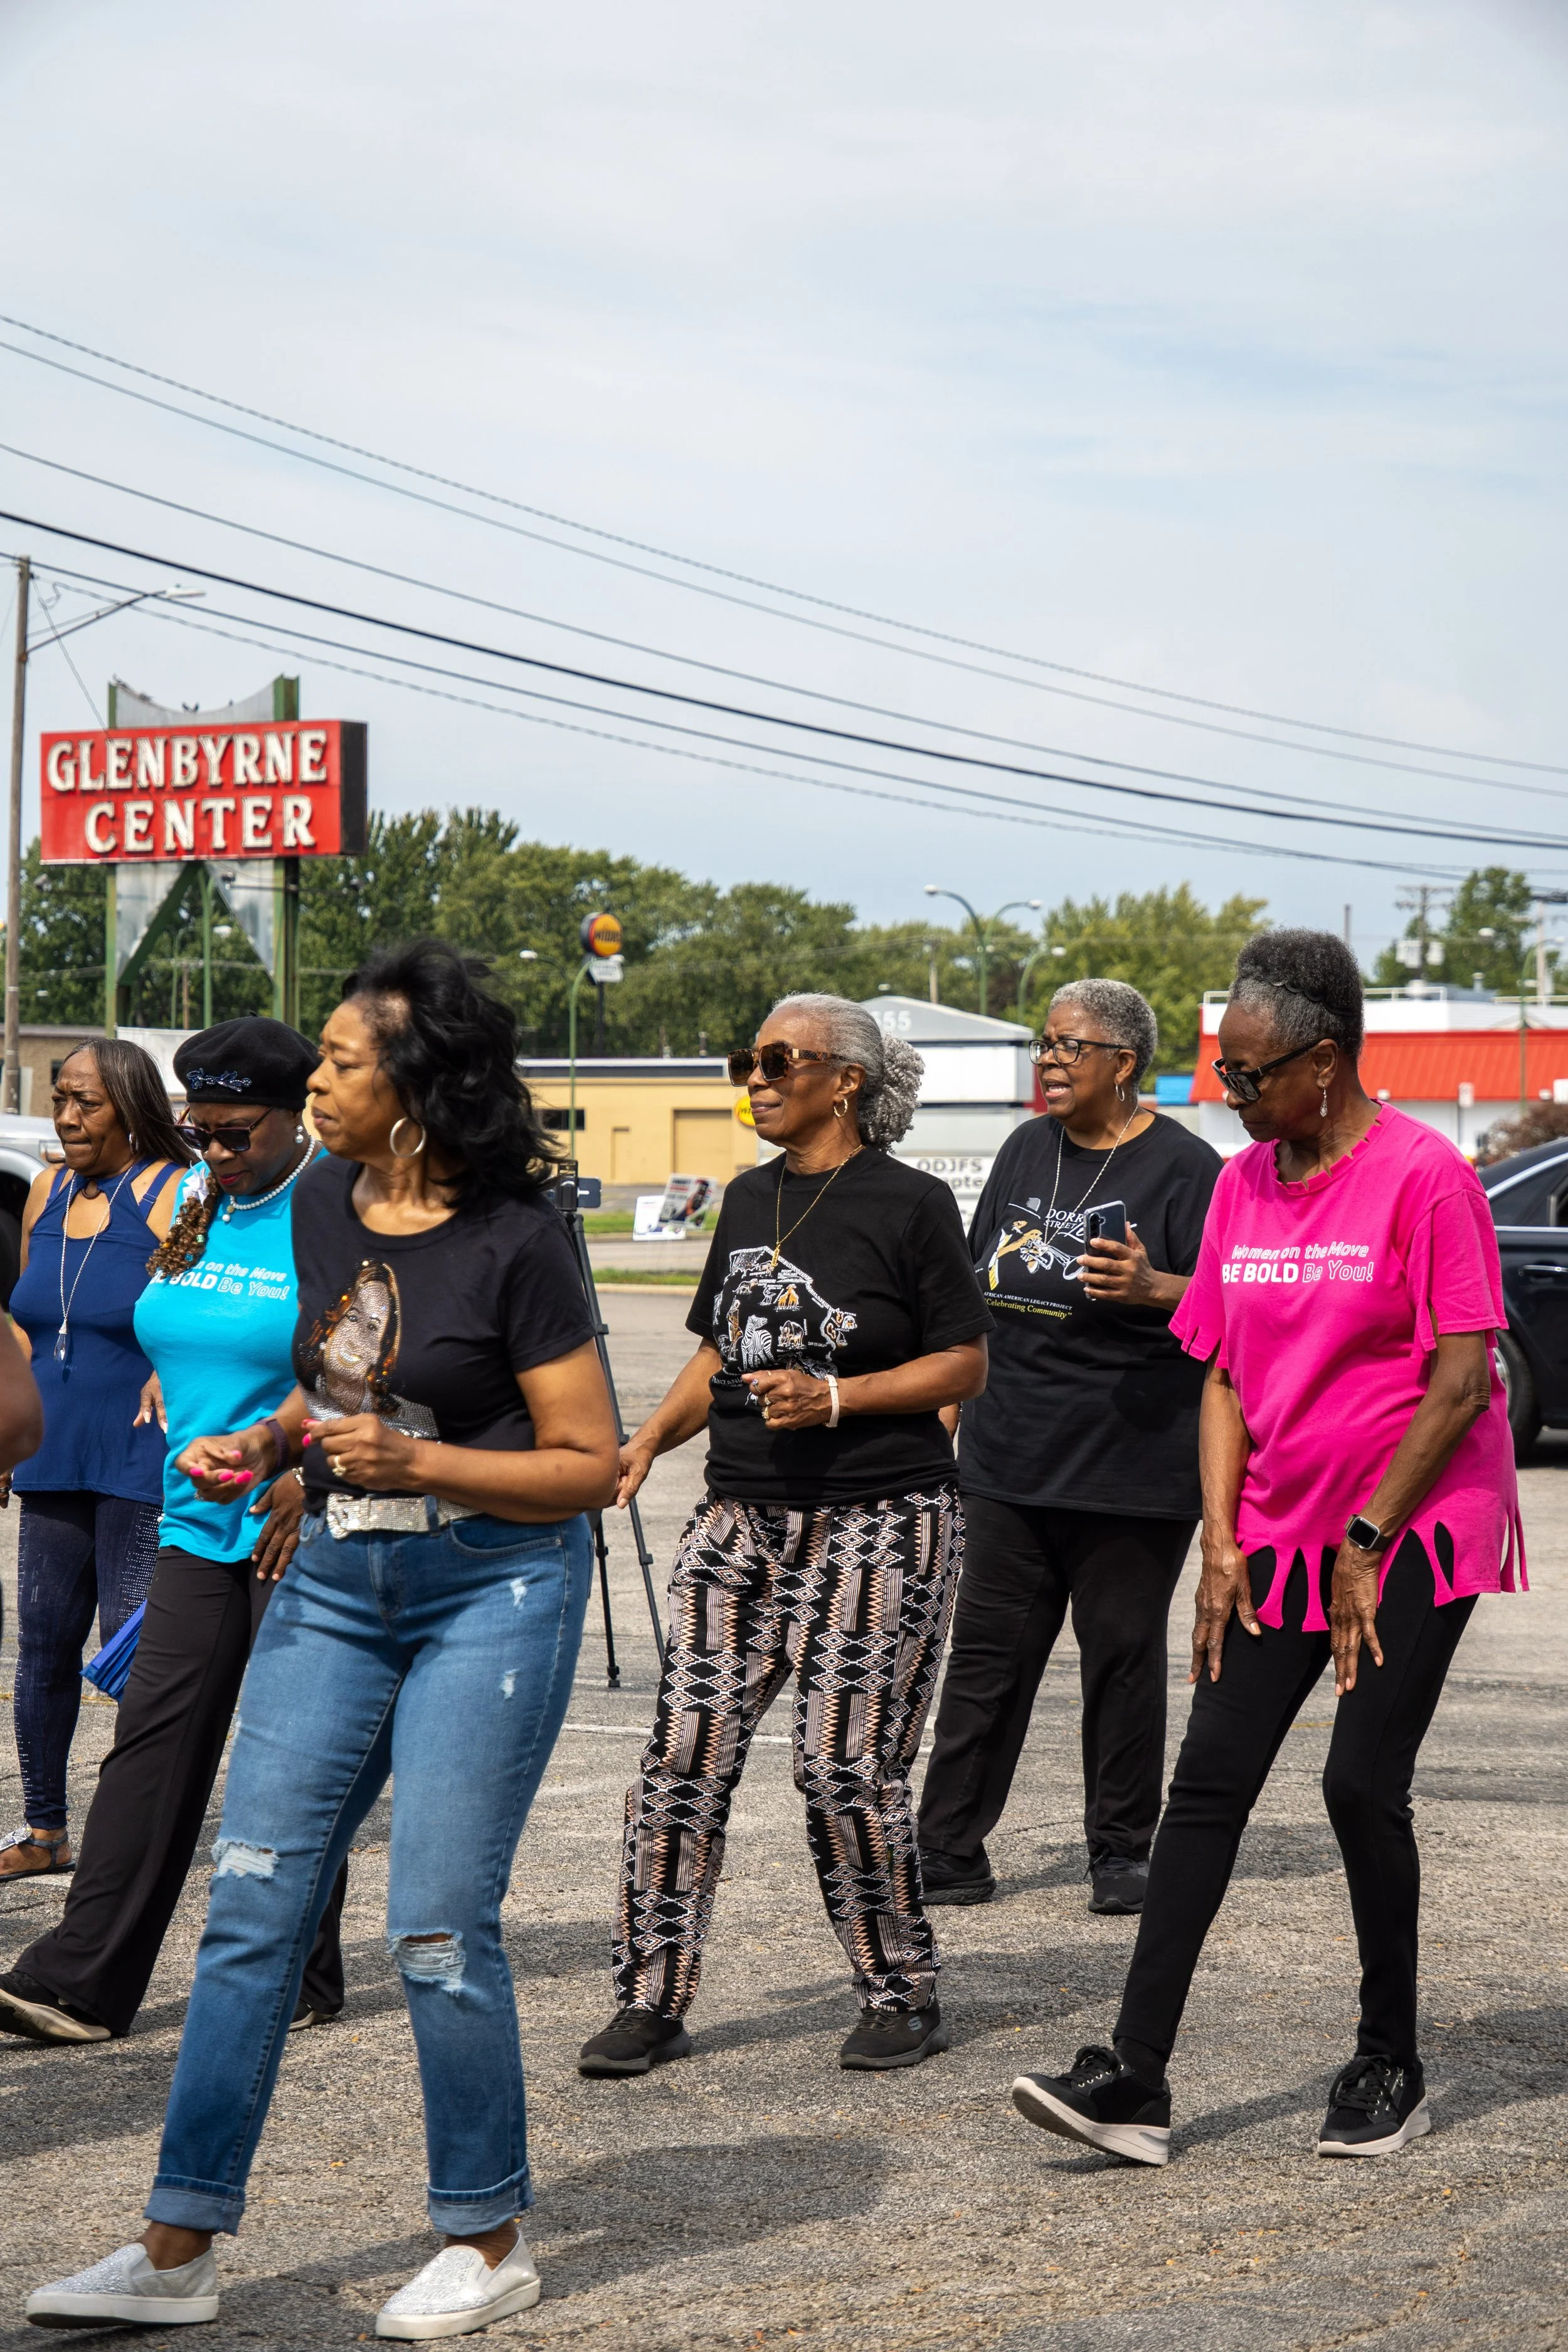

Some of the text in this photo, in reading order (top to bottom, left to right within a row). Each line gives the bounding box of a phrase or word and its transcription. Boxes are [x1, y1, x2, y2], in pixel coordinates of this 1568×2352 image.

[47, 729, 327, 792] GLENBYRNE
[85, 795, 315, 853] CENTER
[918, 1158, 983, 1172] ODJFS
[1043, 1219, 1078, 1229] STREET
[1044, 1209, 1084, 1222] DORR
[1231, 1241, 1369, 1260] Women on the Move
[204, 1261, 224, 1273] on
[225, 1263, 249, 1277] the
[248, 1266, 287, 1282] Move
[1222, 1259, 1374, 1284] BE BOLD Be You!
[218, 1277, 243, 1295] Be
[248, 1281, 290, 1301] You!
[1049, 1302, 1073, 1310] PROJECT
